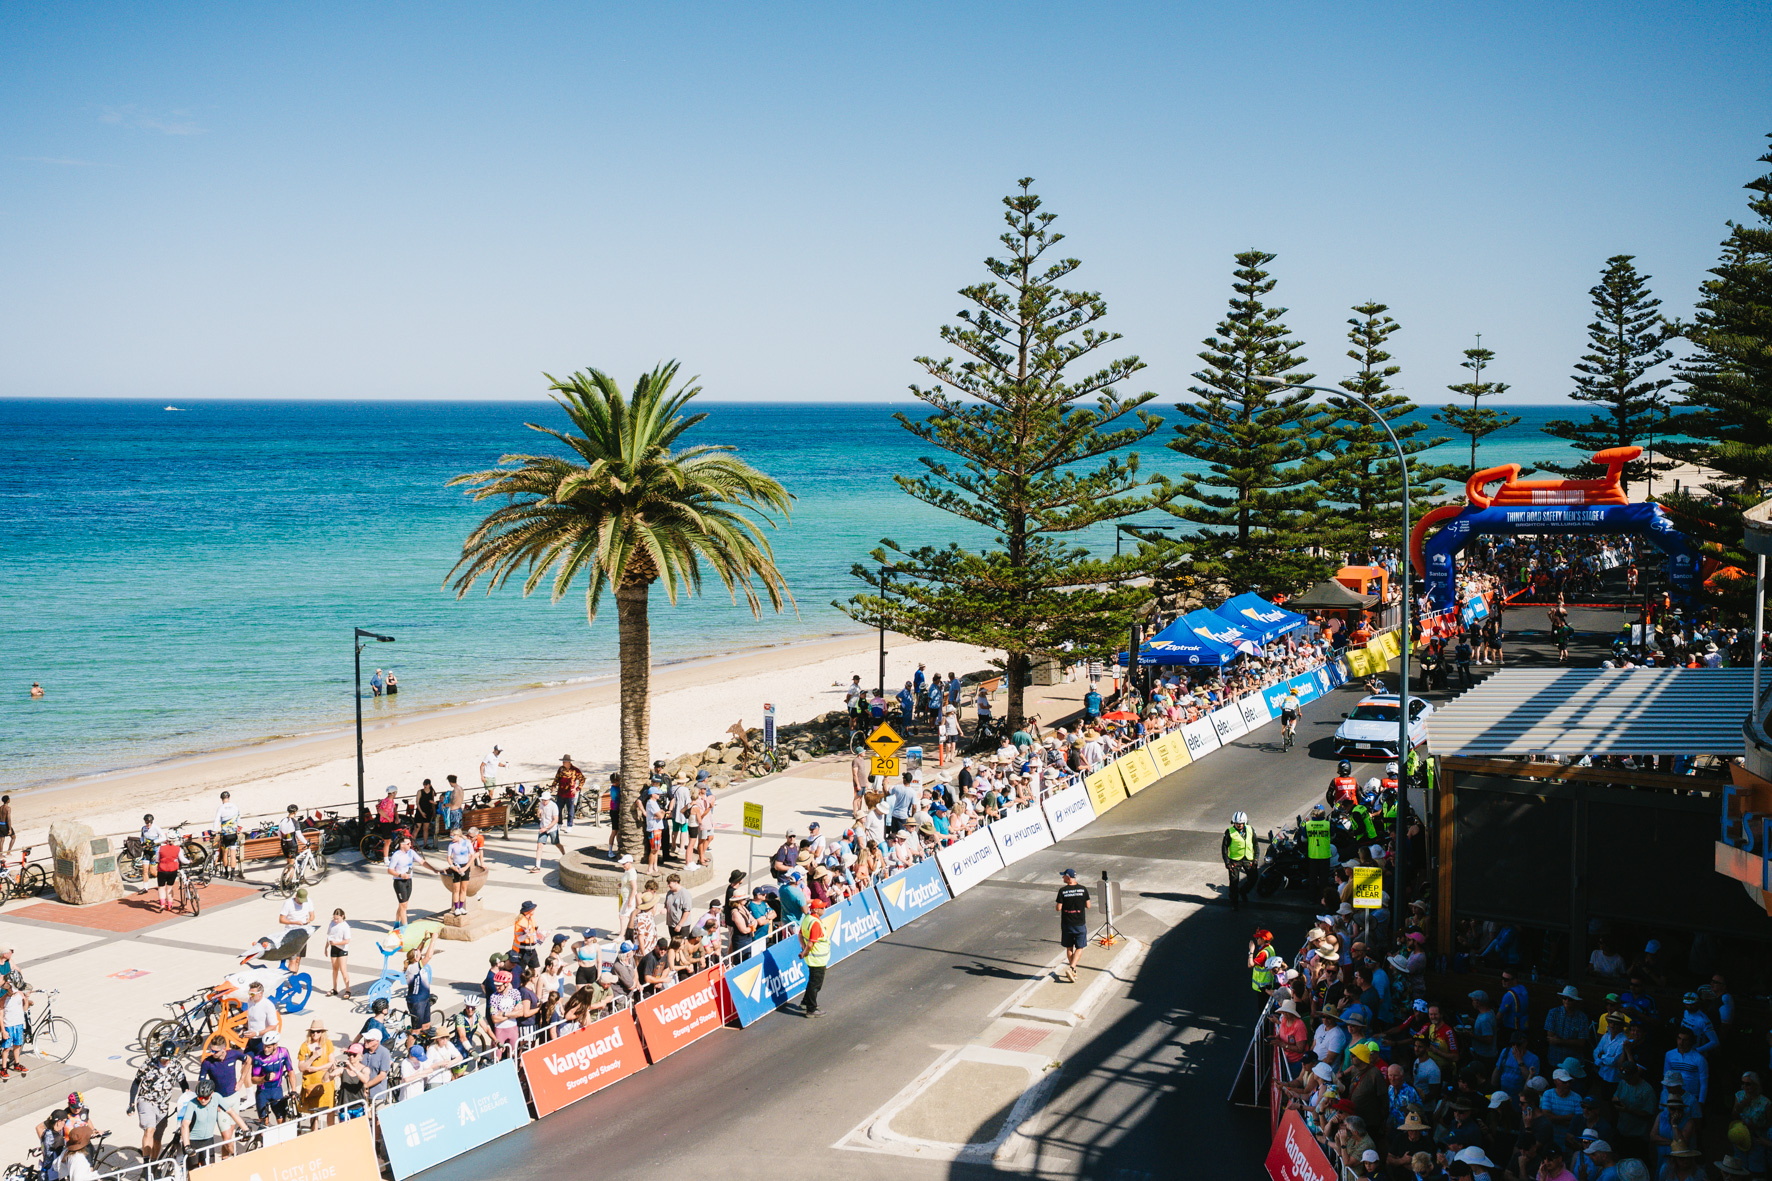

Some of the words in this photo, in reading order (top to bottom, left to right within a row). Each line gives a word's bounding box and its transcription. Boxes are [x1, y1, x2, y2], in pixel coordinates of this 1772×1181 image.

[1507, 512, 1526, 522] THINK!
[1527, 511, 1542, 522] ROAD
[1543, 511, 1562, 522] SAFETY
[1582, 510, 1599, 521] STAGE
[1600, 510, 1604, 520] 4
[877, 758, 894, 769] 20
[1064, 799, 1087, 817] HYUNDAI
[1014, 822, 1042, 841] HYUNDAI
[963, 846, 992, 870] HYUNDAI
[906, 877, 940, 908] Ziptrak
[841, 909, 881, 943] Ziptrak
[762, 960, 805, 999] Ziptrak
[653, 979, 718, 1025] Vanguard
[672, 1024, 690, 1038] Strong
[690, 1020, 699, 1030] and
[699, 1010, 717, 1024] Steady
[543, 1026, 624, 1076] Vanguard
[566, 1072, 588, 1090] Strong
[588, 1068, 599, 1081] and
[599, 1060, 621, 1075] Steady
[478, 1095, 490, 1106] CITY
[492, 1092, 499, 1100] OF
[480, 1096, 509, 1113] ADELAIDE
[281, 1164, 304, 1180] CITY
[309, 1158, 322, 1171] OF
